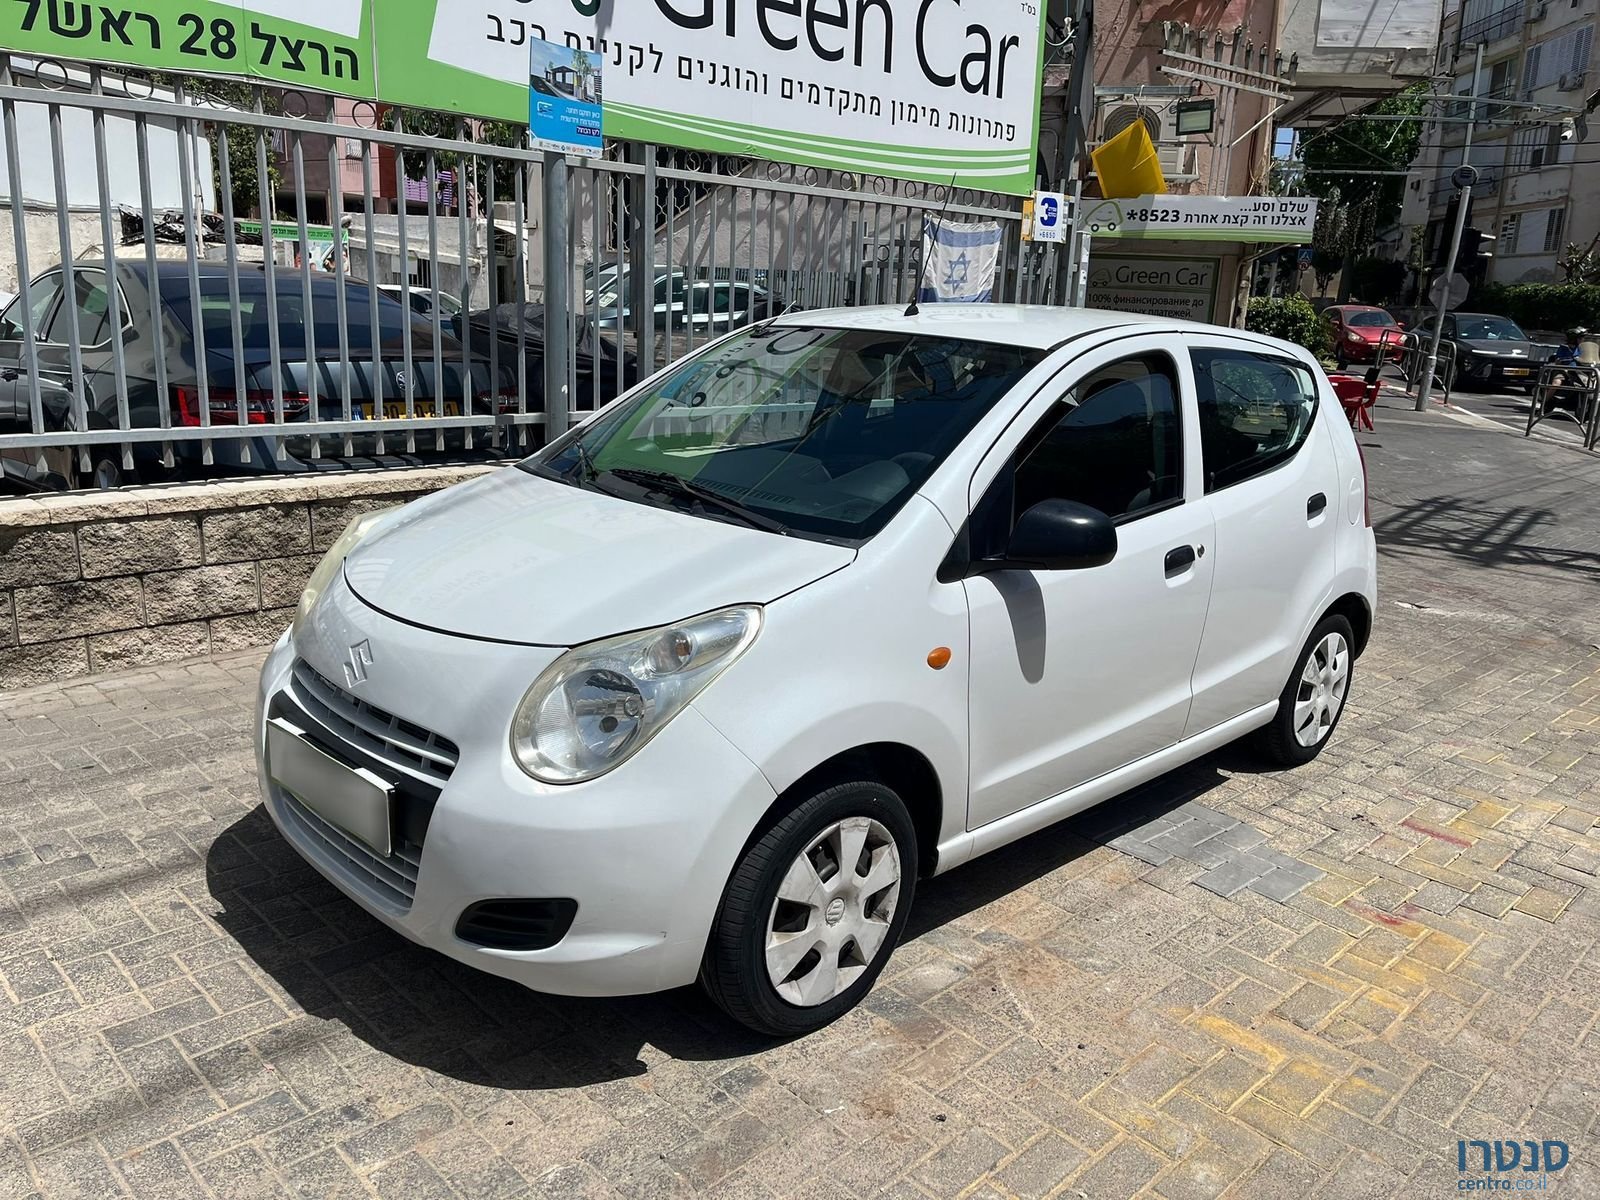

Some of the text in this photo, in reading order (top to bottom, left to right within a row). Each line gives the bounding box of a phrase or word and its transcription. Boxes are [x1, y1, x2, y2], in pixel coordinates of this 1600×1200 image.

[177, 13, 237, 60] 28
[251, 22, 359, 81] הרצל
[653, 0, 1019, 99] een Car
[487, 14, 1015, 142] פתרונות מימון מתקדמים והוגנים לקניית רכב
[1279, 201, 1309, 213] שלם
[1184, 212, 1219, 224] אחרת
[1221, 213, 1249, 228] קצת
[1253, 213, 1268, 225] זה
[1270, 213, 1307, 226] אצלנו
[1115, 265, 1208, 286] Green Car
[1088, 293, 1204, 308] 100% финансирование до
